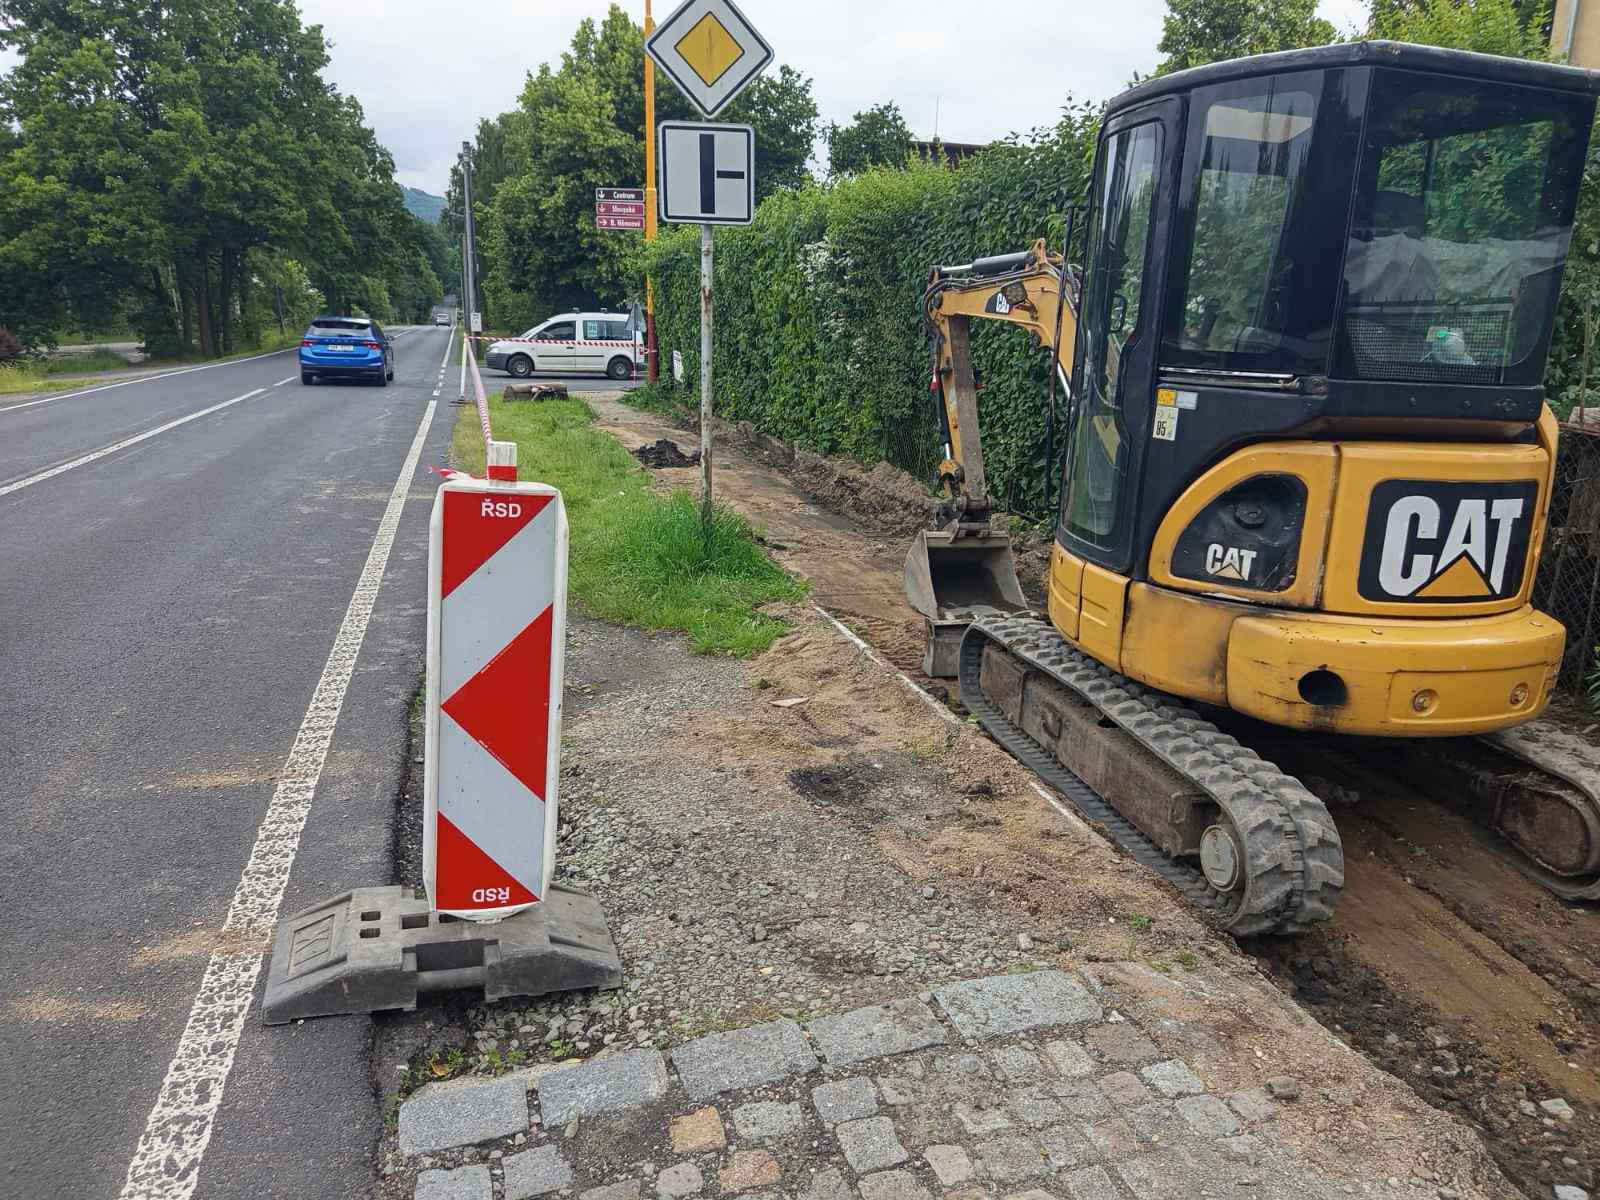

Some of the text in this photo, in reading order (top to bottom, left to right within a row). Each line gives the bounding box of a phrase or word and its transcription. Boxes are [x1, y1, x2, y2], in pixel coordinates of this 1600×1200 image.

[613, 191, 636, 199] Centrum
[481, 498, 521, 518] ŘSD
[1378, 495, 1524, 597] CAT
[1205, 543, 1257, 581] CAT
[472, 886, 510, 904] ŘSD
